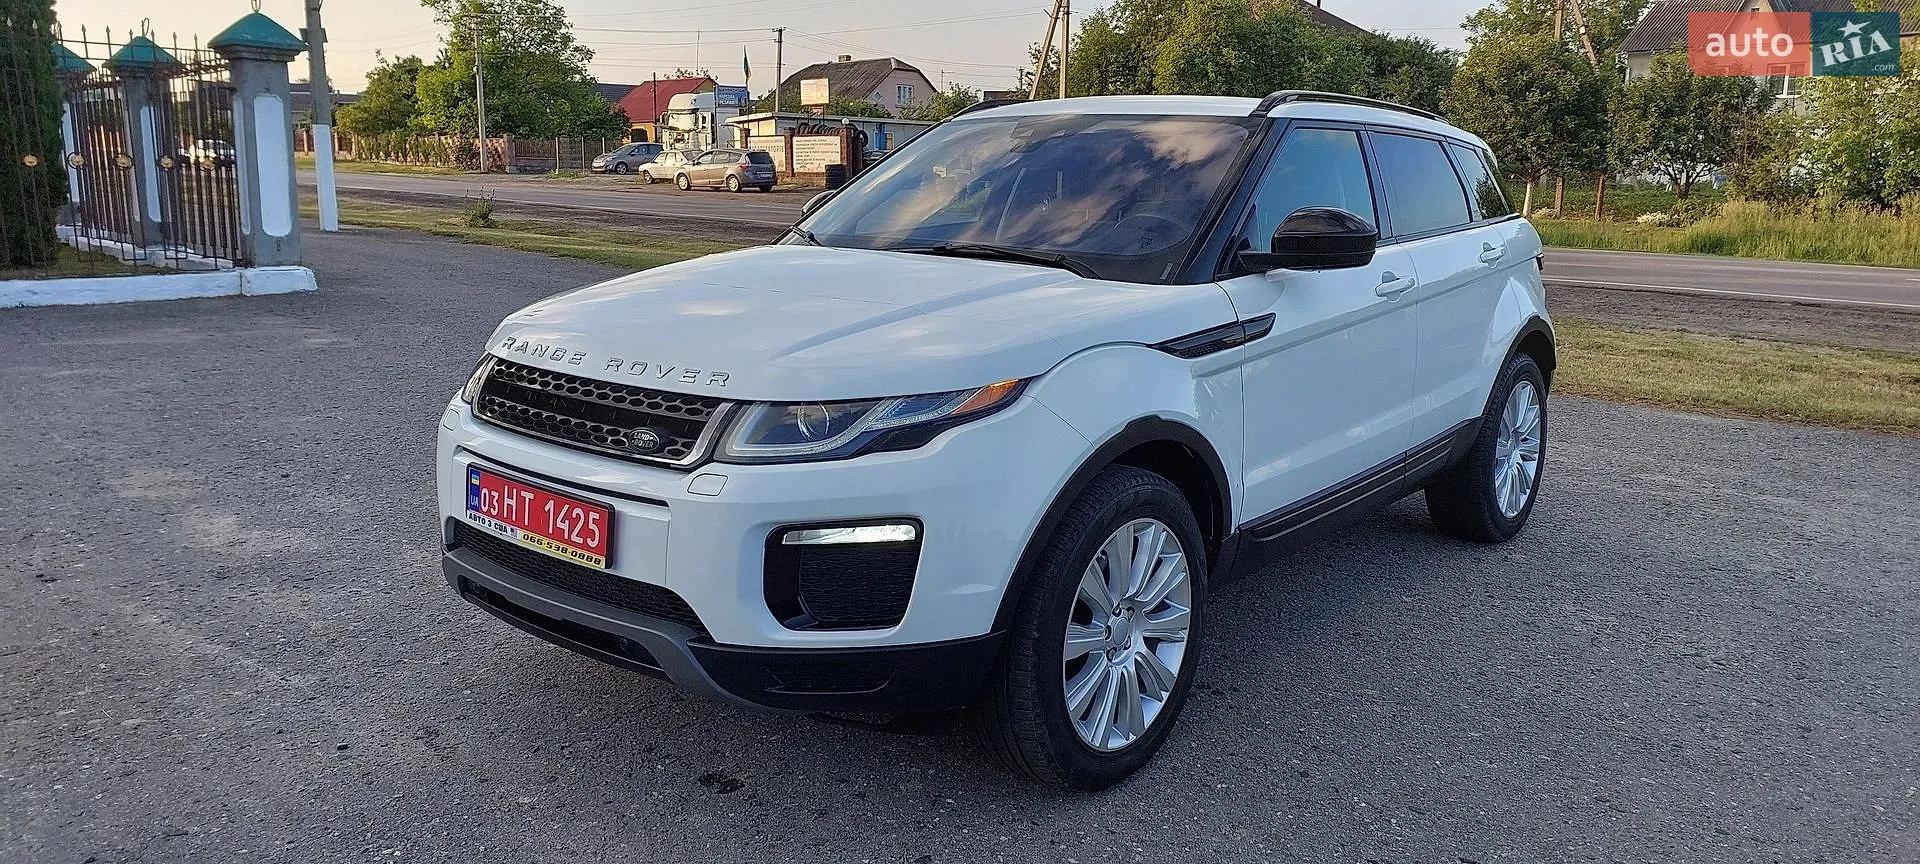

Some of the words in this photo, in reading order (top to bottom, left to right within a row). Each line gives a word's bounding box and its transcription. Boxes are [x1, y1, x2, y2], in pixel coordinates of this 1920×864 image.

[501, 336, 587, 365] RANGE
[604, 357, 730, 387] ROVER
[634, 432, 650, 441] LAND
[634, 439, 654, 448] ROVER
[471, 497, 479, 507] UA
[468, 513, 486, 526] АВТО
[494, 523, 508, 534] США
[480, 487, 499, 515] 03
[503, 485, 535, 526] HT
[544, 499, 600, 548] 1425
